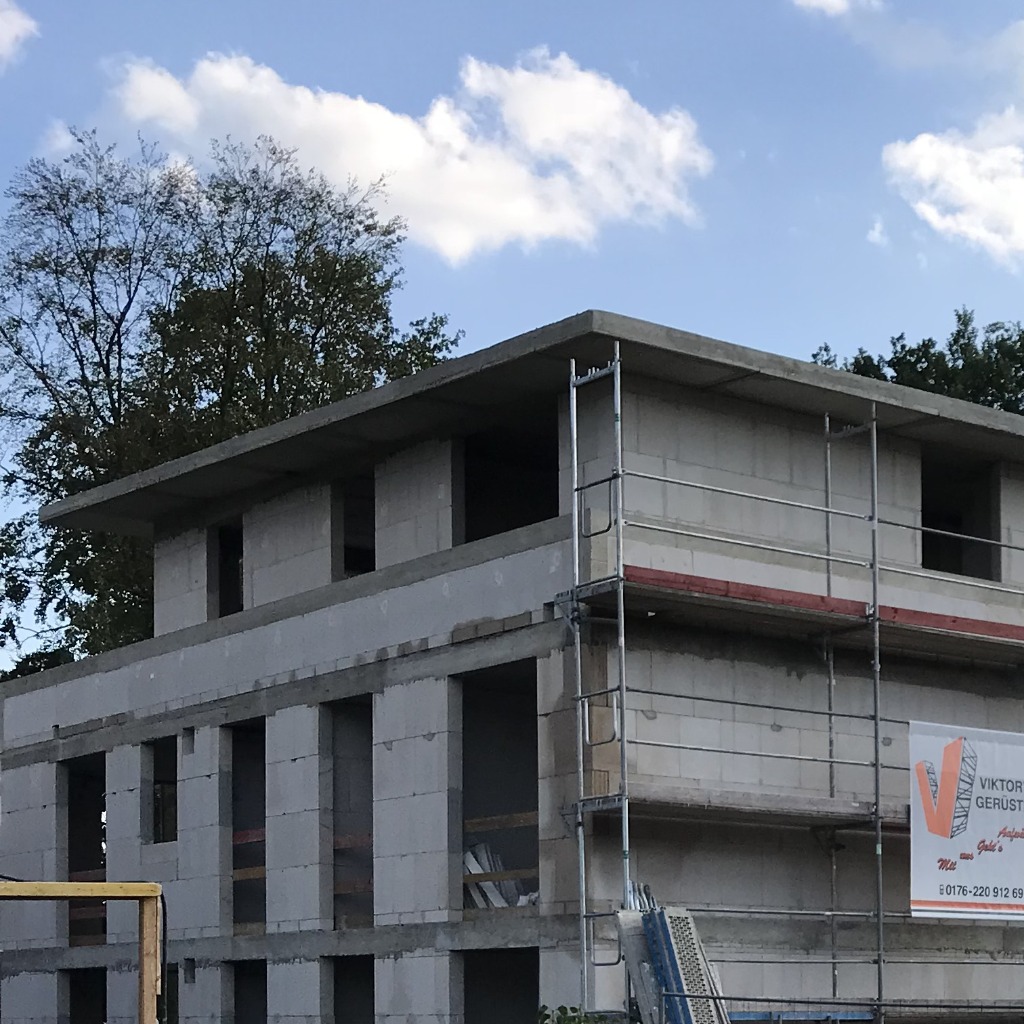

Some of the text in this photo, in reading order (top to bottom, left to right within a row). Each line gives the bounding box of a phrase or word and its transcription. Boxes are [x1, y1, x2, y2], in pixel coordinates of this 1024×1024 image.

[937, 858, 958, 871] Mit
[945, 885, 1024, 899] 0176-220 912 69
